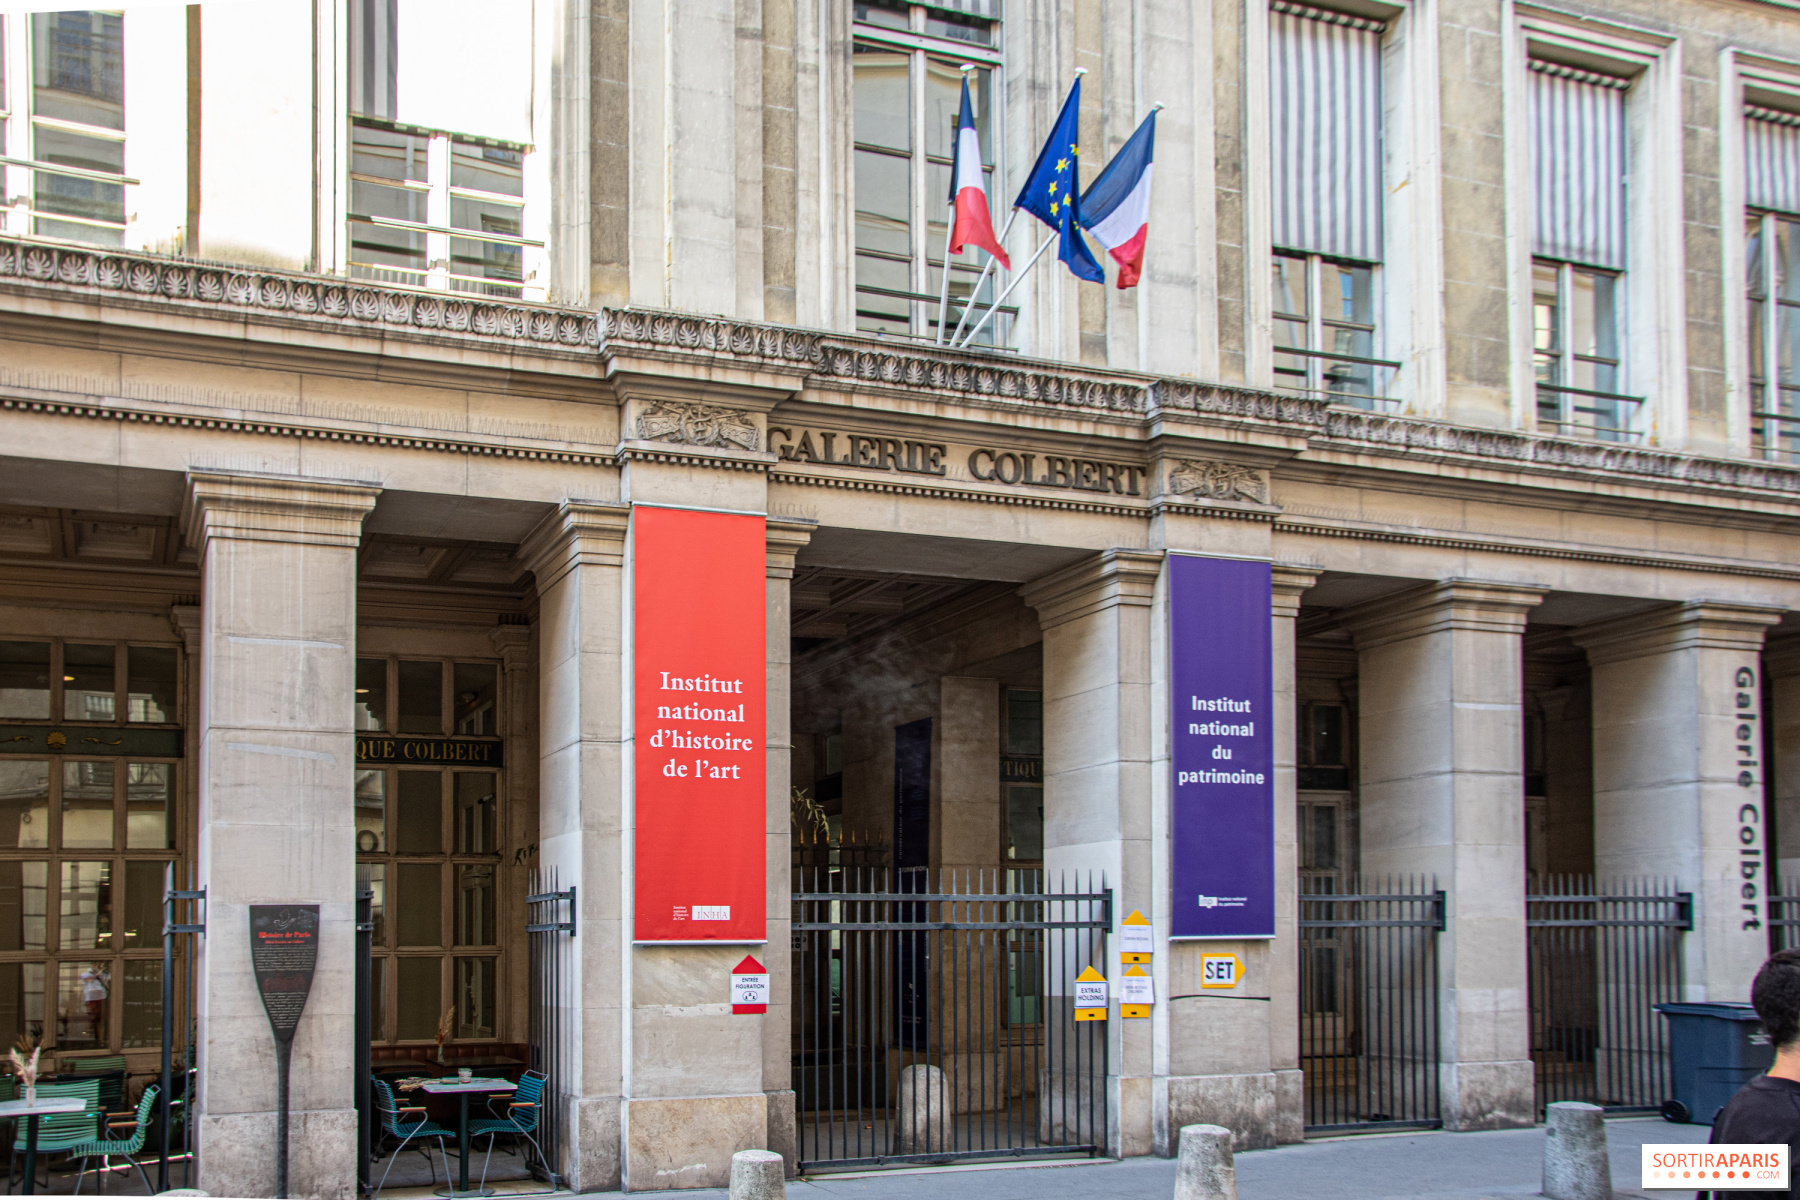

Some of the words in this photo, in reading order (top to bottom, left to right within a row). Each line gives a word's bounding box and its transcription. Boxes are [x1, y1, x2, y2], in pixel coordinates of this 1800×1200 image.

[767, 426, 948, 476] GALERIE
[968, 448, 1147, 496] COLBERT
[660, 671, 743, 694] Institut
[657, 702, 745, 722] national
[1192, 695, 1251, 713] Institut
[1189, 720, 1254, 737] national
[1735, 666, 1758, 788] Galerie
[356, 739, 395, 760] QUE
[403, 742, 492, 761] COLBERT
[649, 729, 753, 751] d'histoire
[1211, 744, 1232, 760] du
[662, 758, 688, 777] de
[695, 759, 741, 779] l'art
[1178, 768, 1265, 786] patrimoine
[1739, 803, 1762, 931] Colbert
[697, 911, 728, 919] INHA
[1205, 961, 1234, 980] SET
